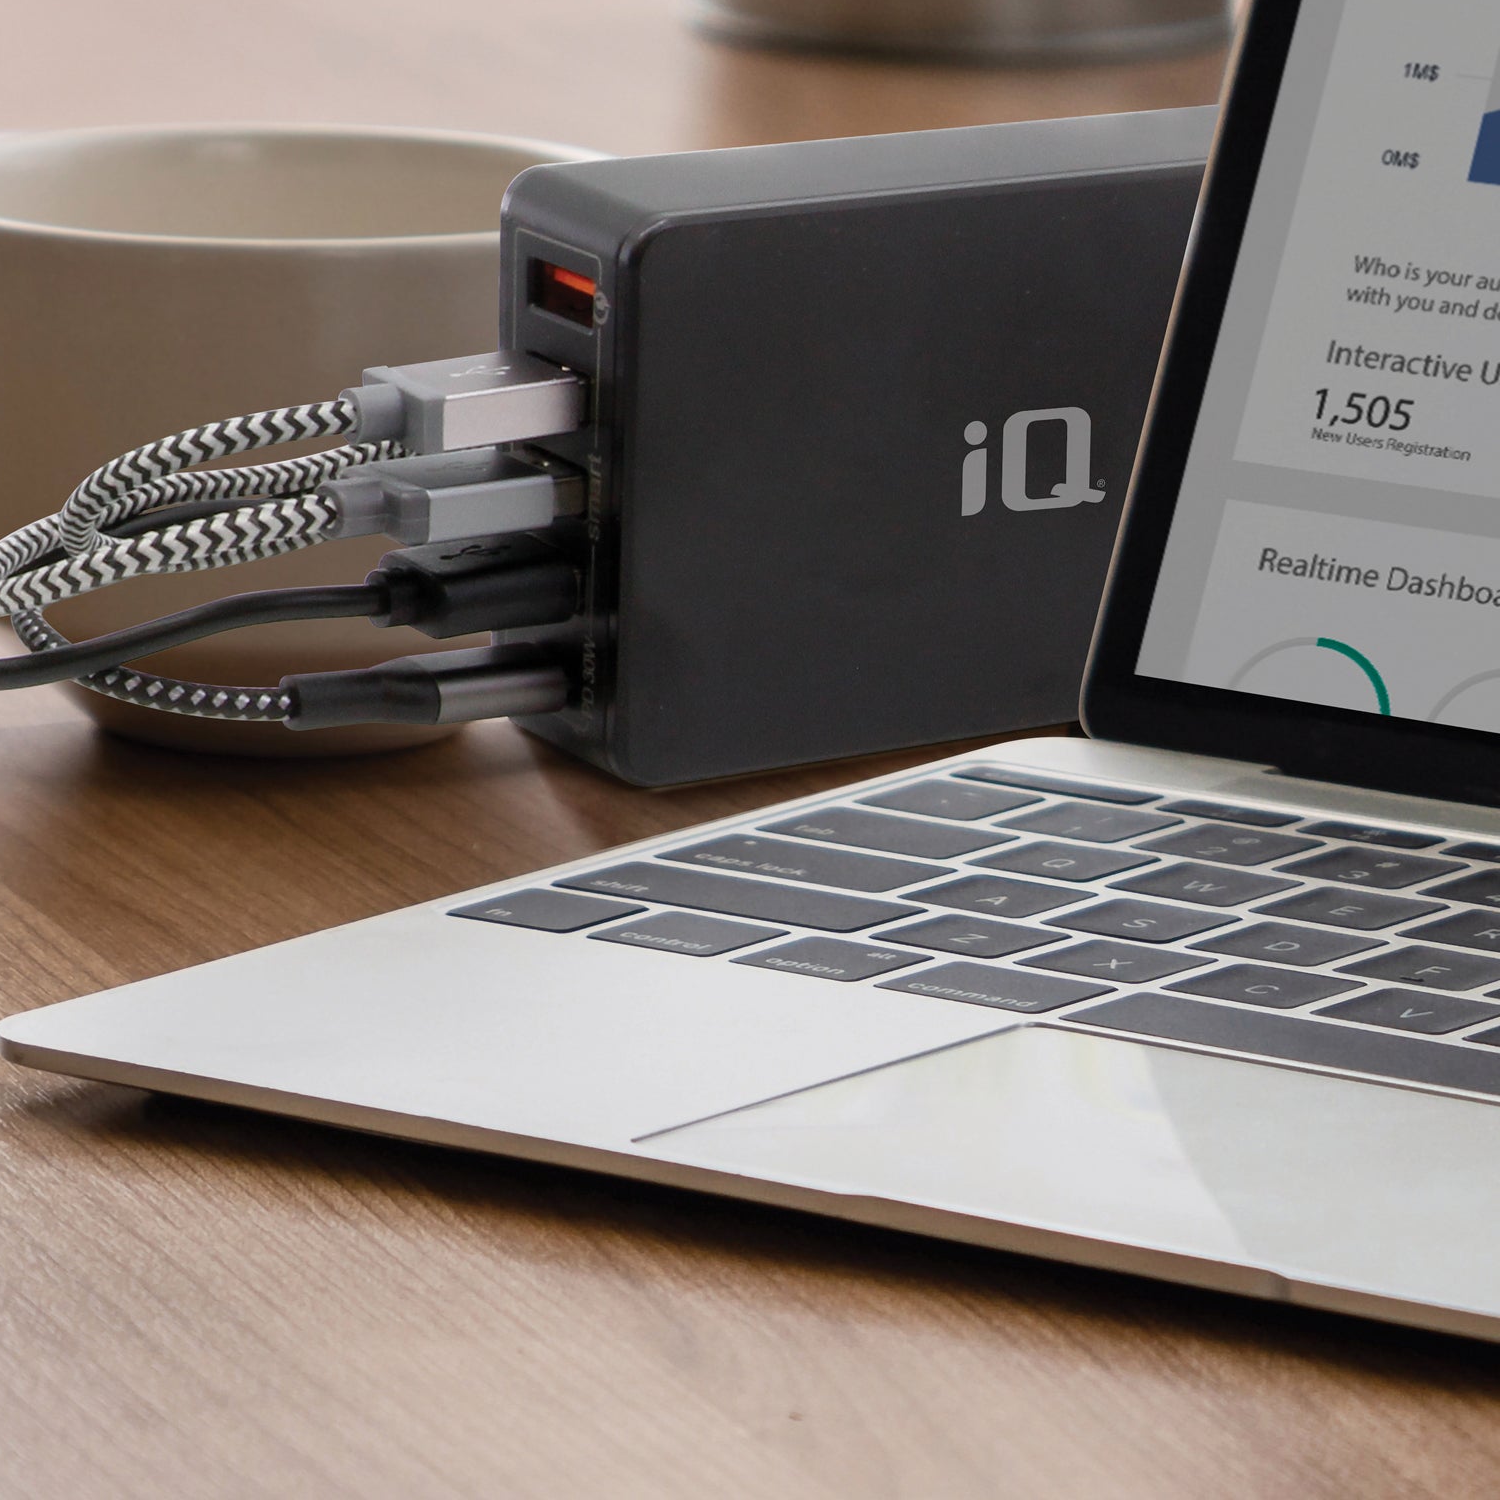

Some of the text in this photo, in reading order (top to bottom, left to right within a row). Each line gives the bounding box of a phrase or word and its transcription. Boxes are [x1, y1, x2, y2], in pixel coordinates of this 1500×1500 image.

[1404, 62, 1441, 82] 1M$
[1354, 254, 1401, 278] Who
[1404, 262, 1421, 281] is
[1423, 269, 1474, 288] your
[1346, 285, 1392, 306] with
[1393, 294, 1435, 313] you
[1438, 299, 1480, 318] and
[1326, 339, 1473, 382] Interactive
[1315, 388, 1415, 431] 1,505
[1311, 427, 1472, 462] New Users Registration
[1257, 548, 1380, 588] Realtime
[694, 852, 807, 876] caps lock
[1338, 870, 1370, 880] 3
[590, 879, 649, 893] shift
[1183, 880, 1226, 893] W
[975, 895, 1008, 906] A
[1329, 905, 1364, 917] E
[1122, 918, 1157, 929] S
[619, 930, 713, 951] control
[949, 933, 989, 944] Z
[1263, 941, 1301, 951] D
[765, 956, 847, 975] option
[1092, 958, 1133, 970] X
[1414, 965, 1451, 975] F
[907, 980, 1037, 1008] command
[1244, 984, 1280, 995] C
[1399, 1008, 1434, 1019] V
